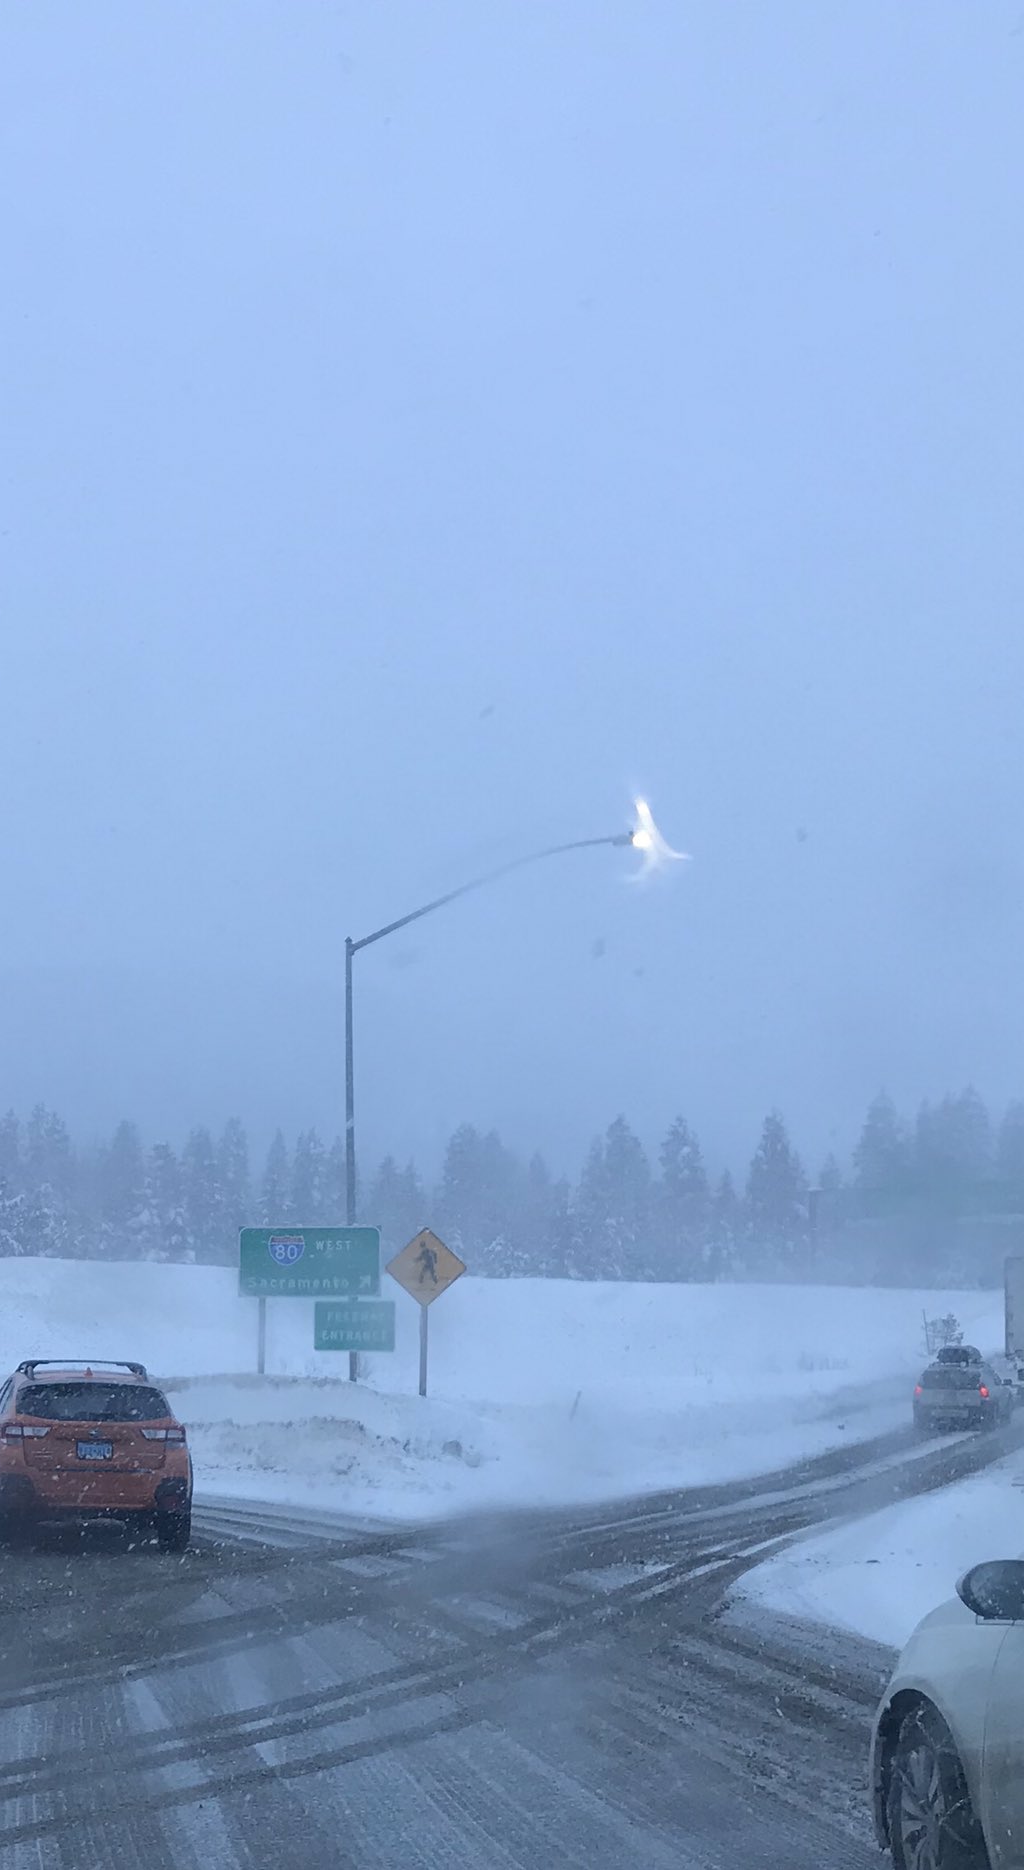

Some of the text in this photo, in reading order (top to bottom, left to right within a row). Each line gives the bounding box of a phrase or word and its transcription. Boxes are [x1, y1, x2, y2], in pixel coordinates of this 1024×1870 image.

[275, 1244, 297, 1260] 80
[315, 1240, 352, 1251] WEST
[247, 1276, 350, 1290] Sacramento
